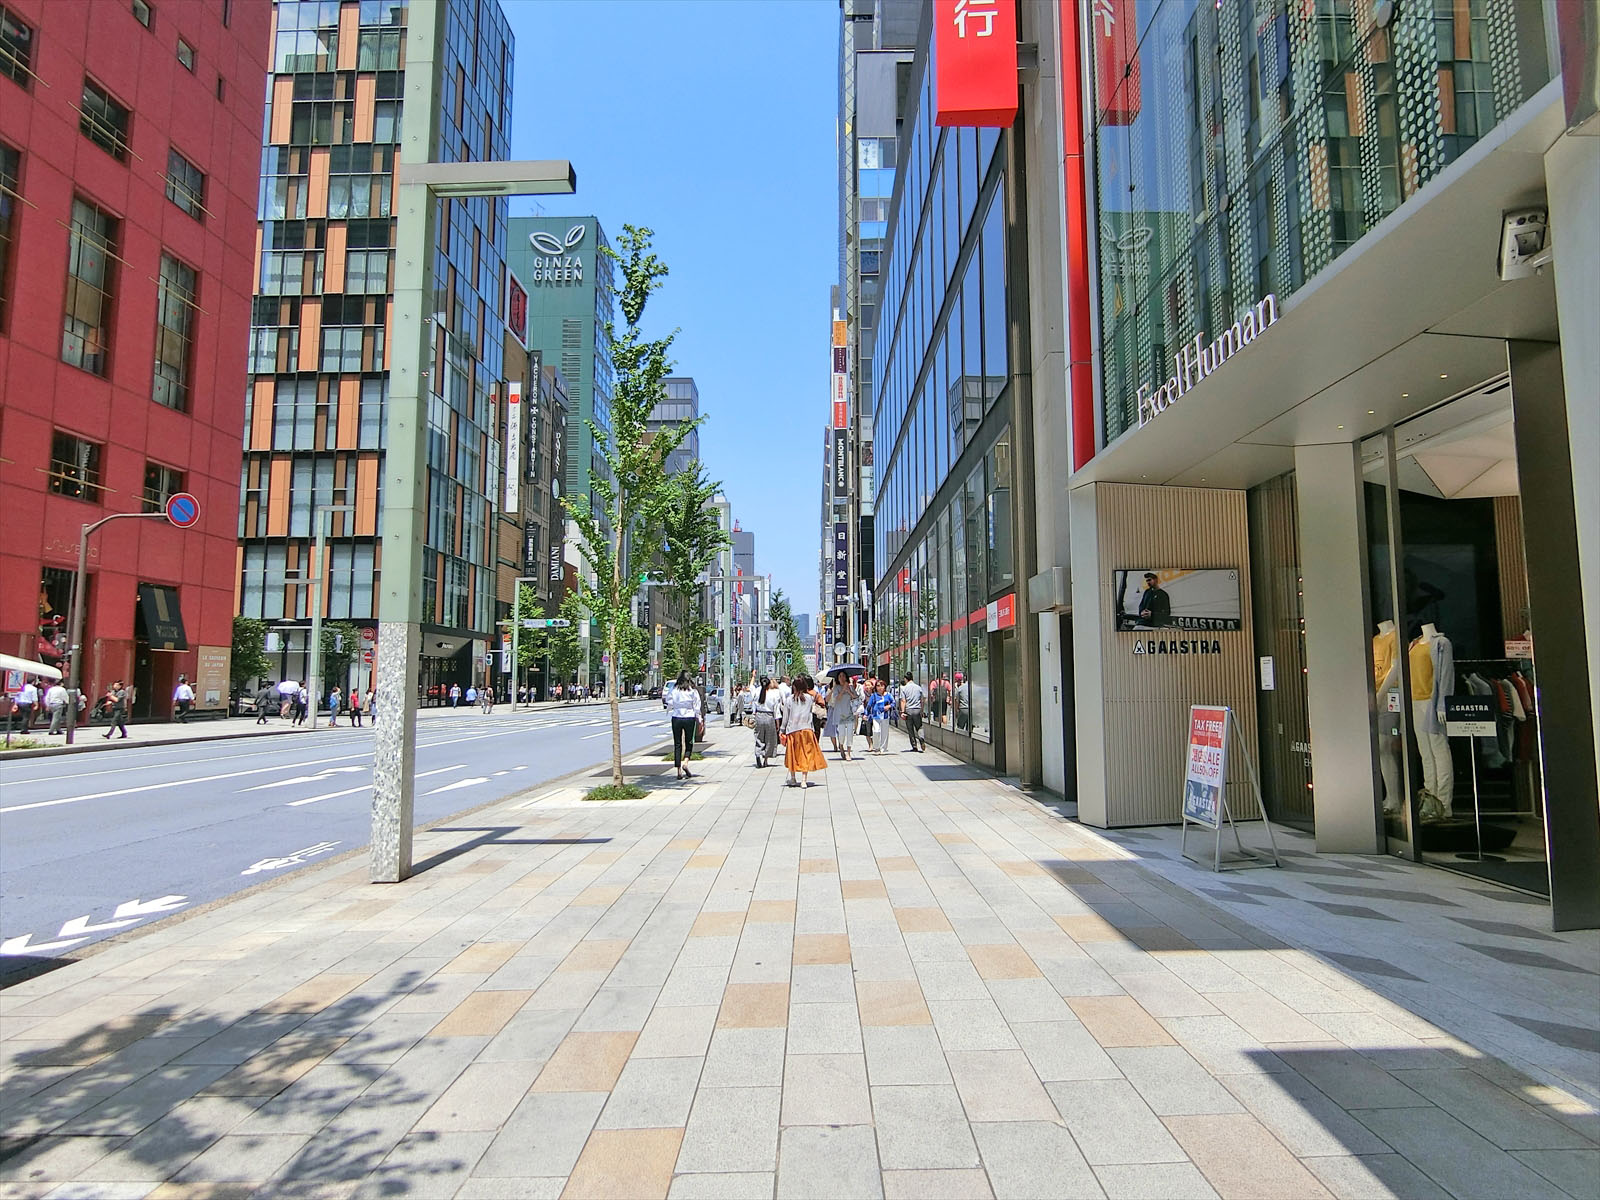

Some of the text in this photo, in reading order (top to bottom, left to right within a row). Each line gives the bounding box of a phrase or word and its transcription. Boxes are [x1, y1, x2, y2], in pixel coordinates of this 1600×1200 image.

[953, 0, 999, 38] 行
[533, 257, 583, 269] GINZA
[533, 269, 583, 282] GREEN
[1136, 293, 1278, 430] ExcelHuman
[837, 438, 845, 481] MONTBLANC
[550, 546, 560, 581] DAMIANI
[836, 532, 847, 580] 日新堂
[1177, 617, 1235, 630] GAASTRA
[1147, 640, 1221, 655] GAASTRA
[1194, 720, 1219, 732] TAX FREE
